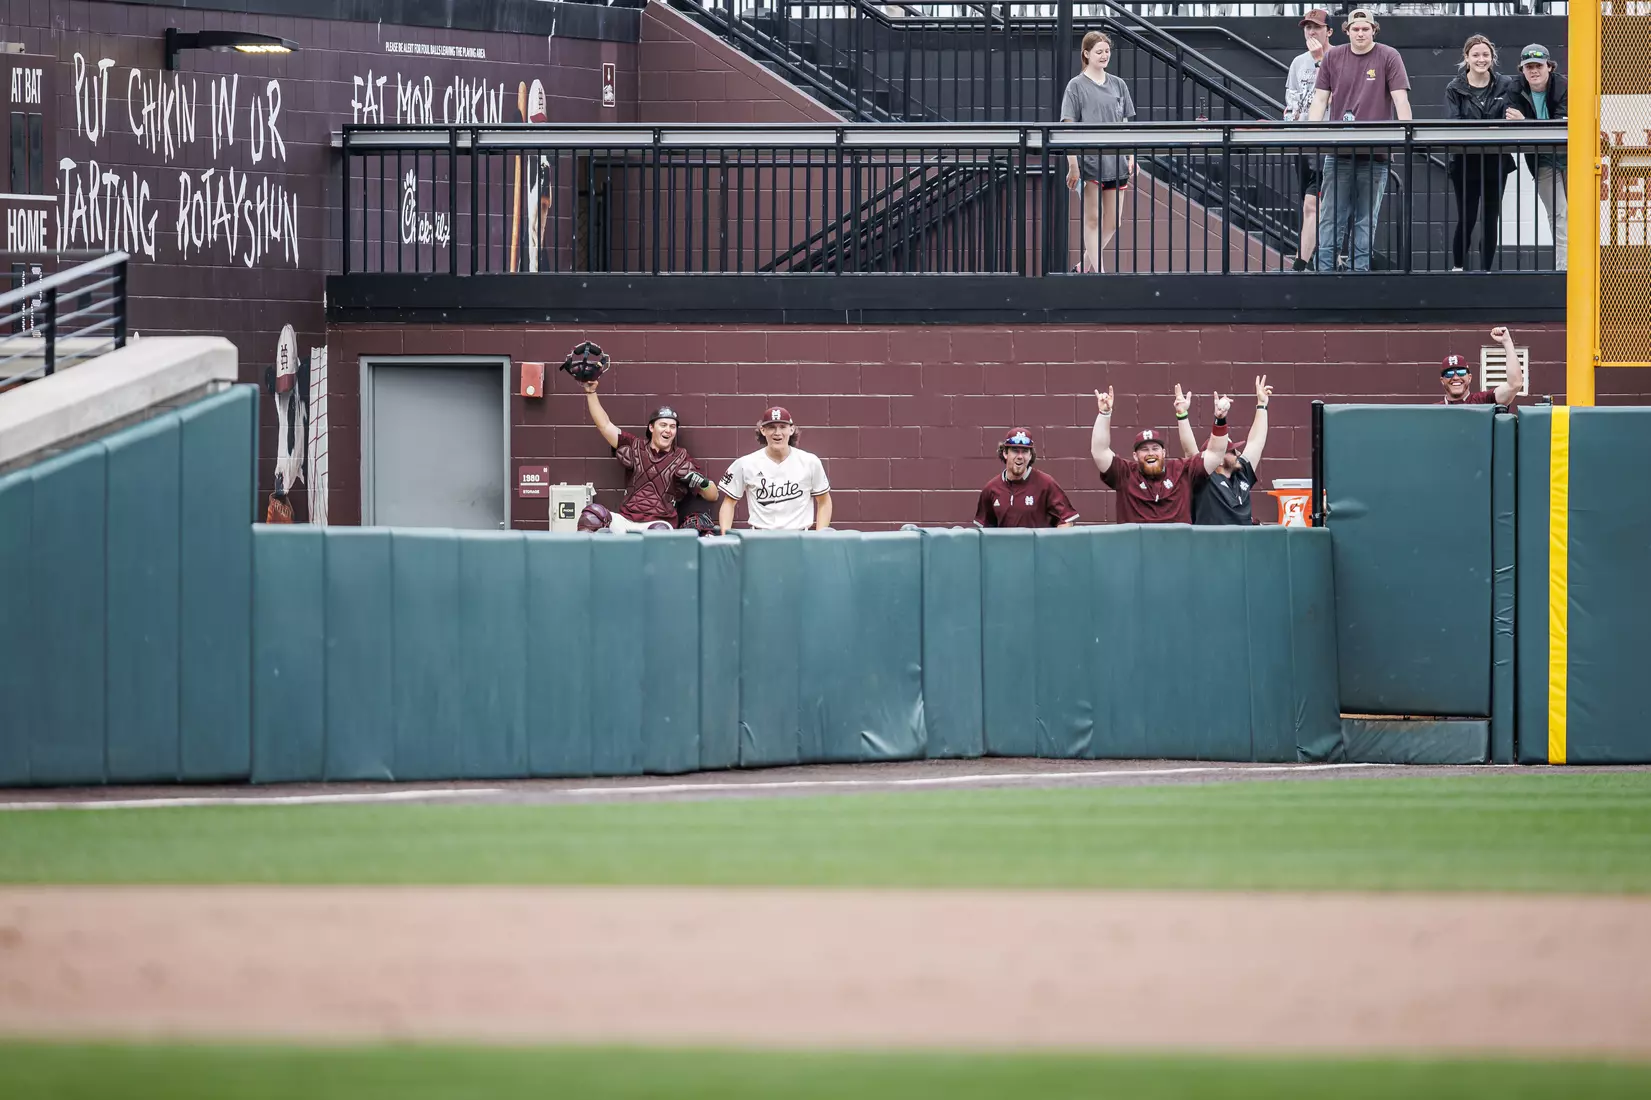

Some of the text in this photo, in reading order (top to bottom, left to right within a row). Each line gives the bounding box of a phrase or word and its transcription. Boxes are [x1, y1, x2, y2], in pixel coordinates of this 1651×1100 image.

[385, 41, 398, 52] PLEASE
[399, 42, 403, 52] BE
[404, 42, 414, 53] ALERT
[422, 44, 430, 54] FOUL
[430, 44, 440, 55] BALLS
[440, 45, 455, 56] LEAVING
[463, 47, 476, 58] PLAYING
[476, 48, 486, 58] AREA
[11, 68, 42, 104] AT BAT
[397, 72, 434, 126] MOR
[444, 76, 504, 126] CHIKIN
[74, 52, 286, 165] PUT CHIKIN IN UR
[7, 208, 48, 252] HOME
[176, 166, 299, 268] ROTAYSHUN
[756, 478, 802, 503] State
